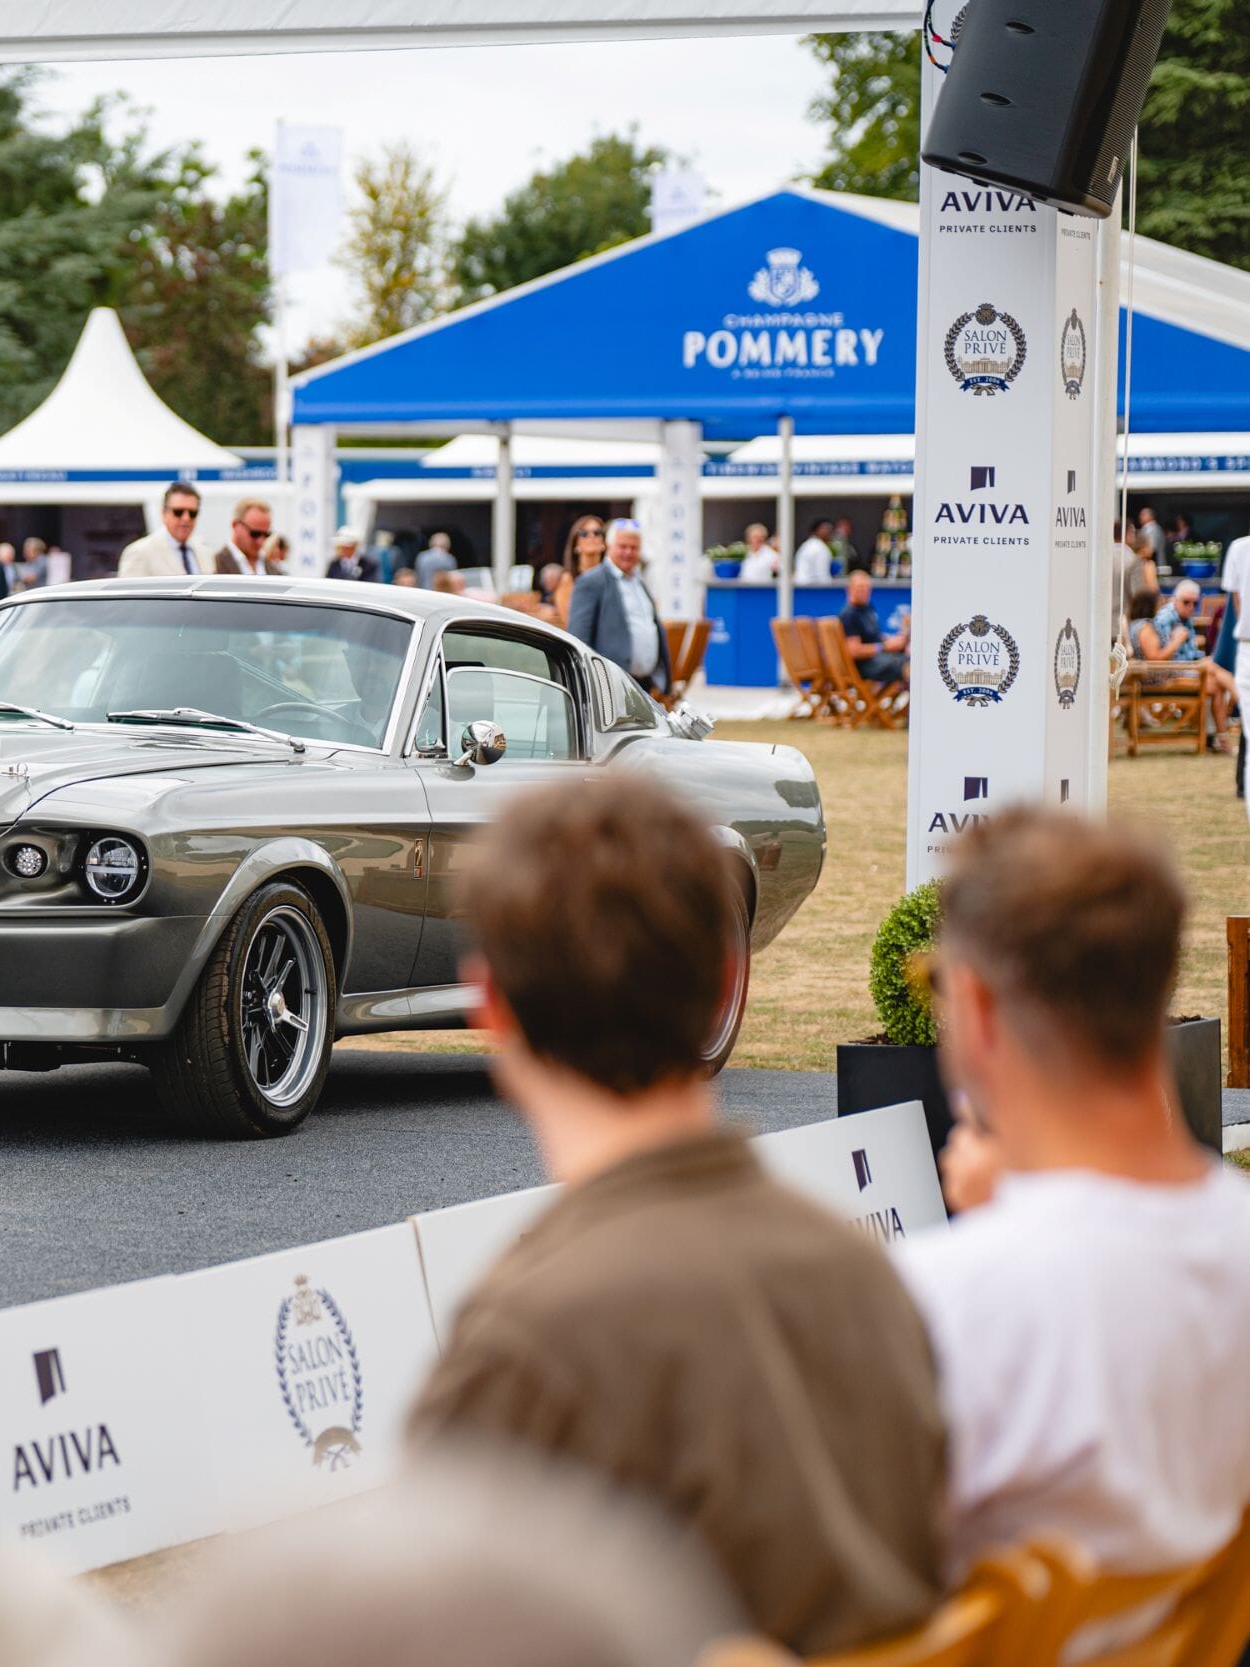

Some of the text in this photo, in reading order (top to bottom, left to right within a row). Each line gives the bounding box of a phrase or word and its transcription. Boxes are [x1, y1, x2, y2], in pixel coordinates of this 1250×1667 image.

[940, 191, 1037, 212] AVIVA
[939, 224, 1037, 233] PRIVATE CLIENTS
[723, 312, 845, 329] CHAMPAGNE
[964, 330, 1007, 342] SALON
[682, 328, 885, 369] POMMERY
[964, 341, 1007, 354] PRIVÉ
[934, 503, 1030, 524] AVIVA
[1055, 507, 1086, 528] AVIVA
[933, 536, 1030, 546] PRIVATE CLIENTS
[957, 641, 1000, 653] SALON
[957, 653, 1000, 666] PRIVÉ
[287, 1332, 343, 1375] SALON
[295, 1366, 351, 1414] PRIVÉ
[13, 1422, 122, 1492] AVIVA
[20, 1495, 132, 1540] PRIVATE CLIENTS
